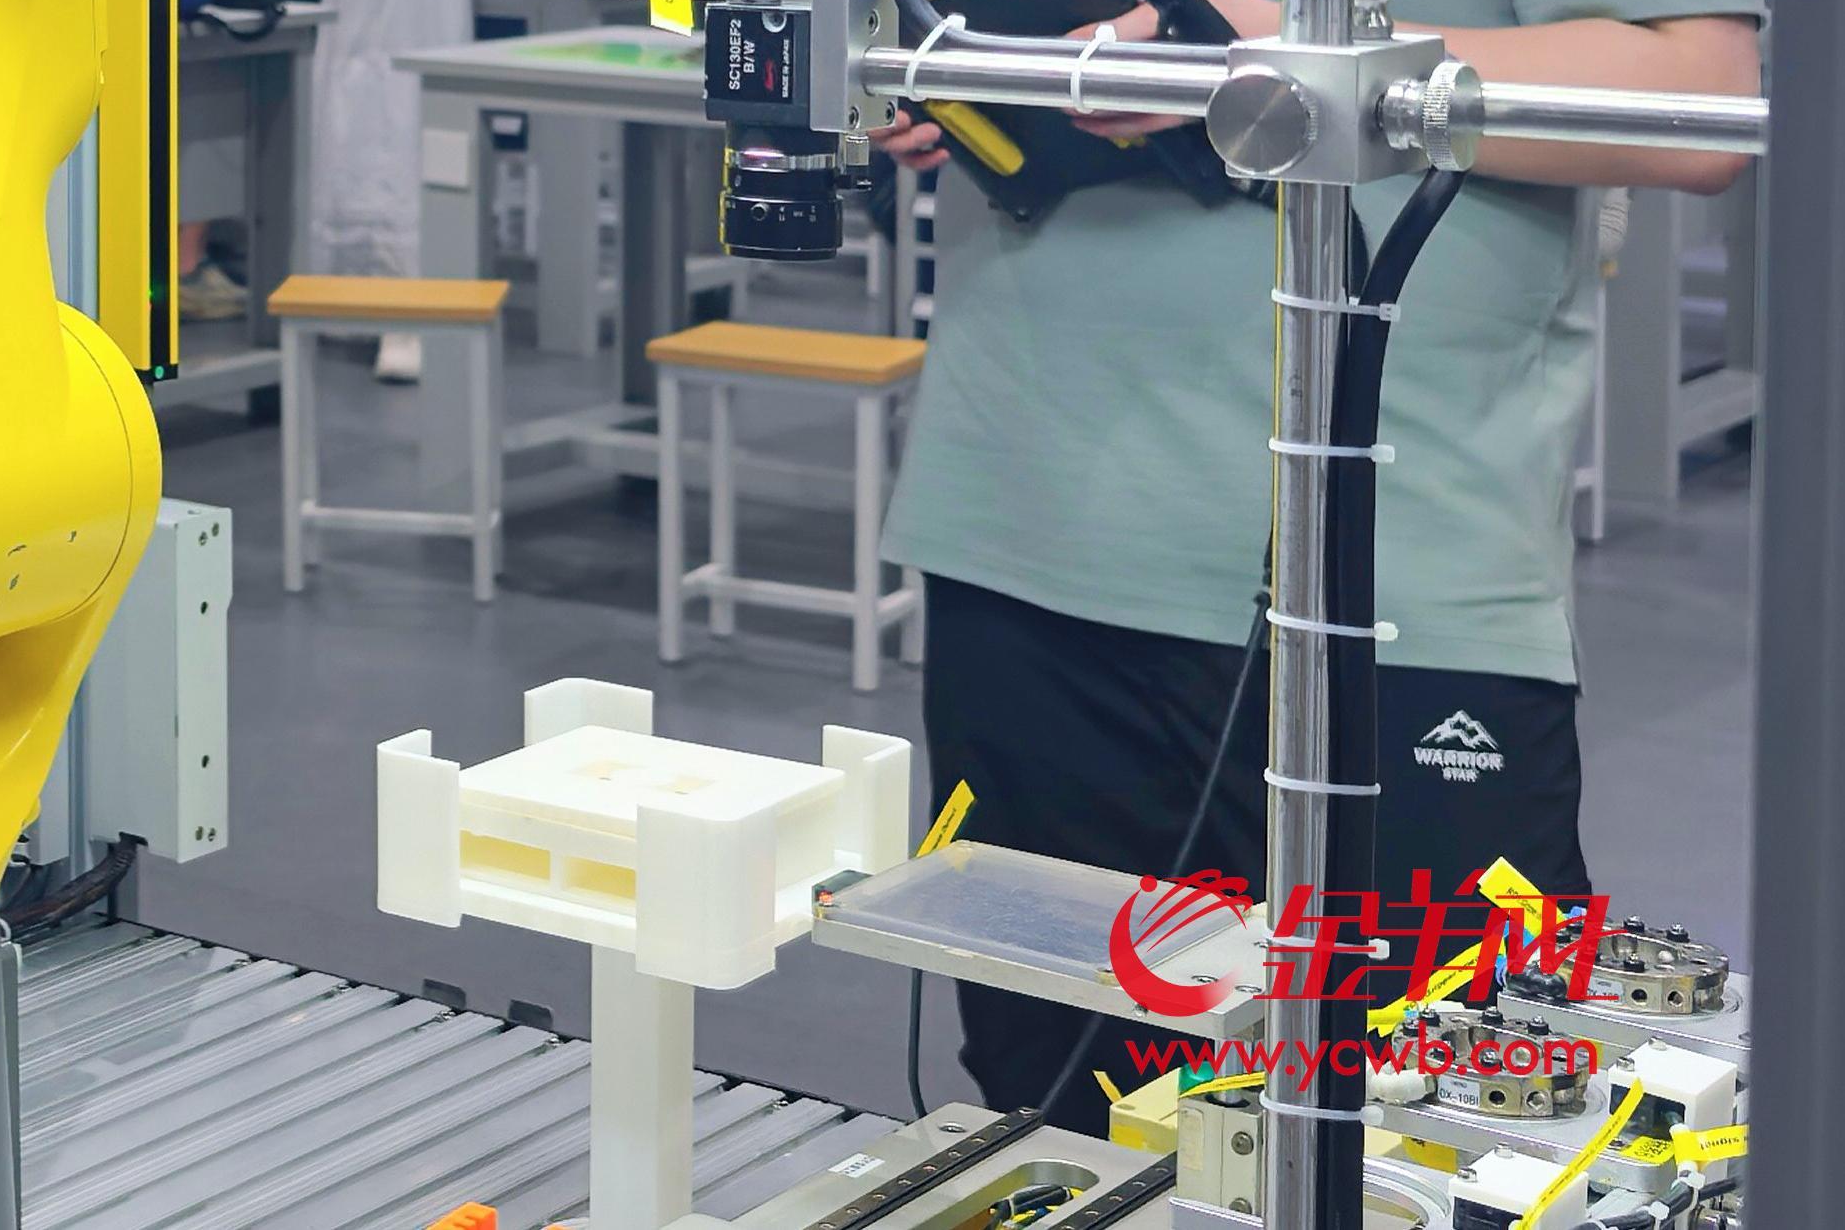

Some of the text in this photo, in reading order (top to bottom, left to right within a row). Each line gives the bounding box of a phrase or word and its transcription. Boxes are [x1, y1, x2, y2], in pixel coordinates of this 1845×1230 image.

[728, 18, 742, 90] SC130EF2
[742, 40, 755, 74] B/W
[1413, 746, 1505, 771] WARRIOR
